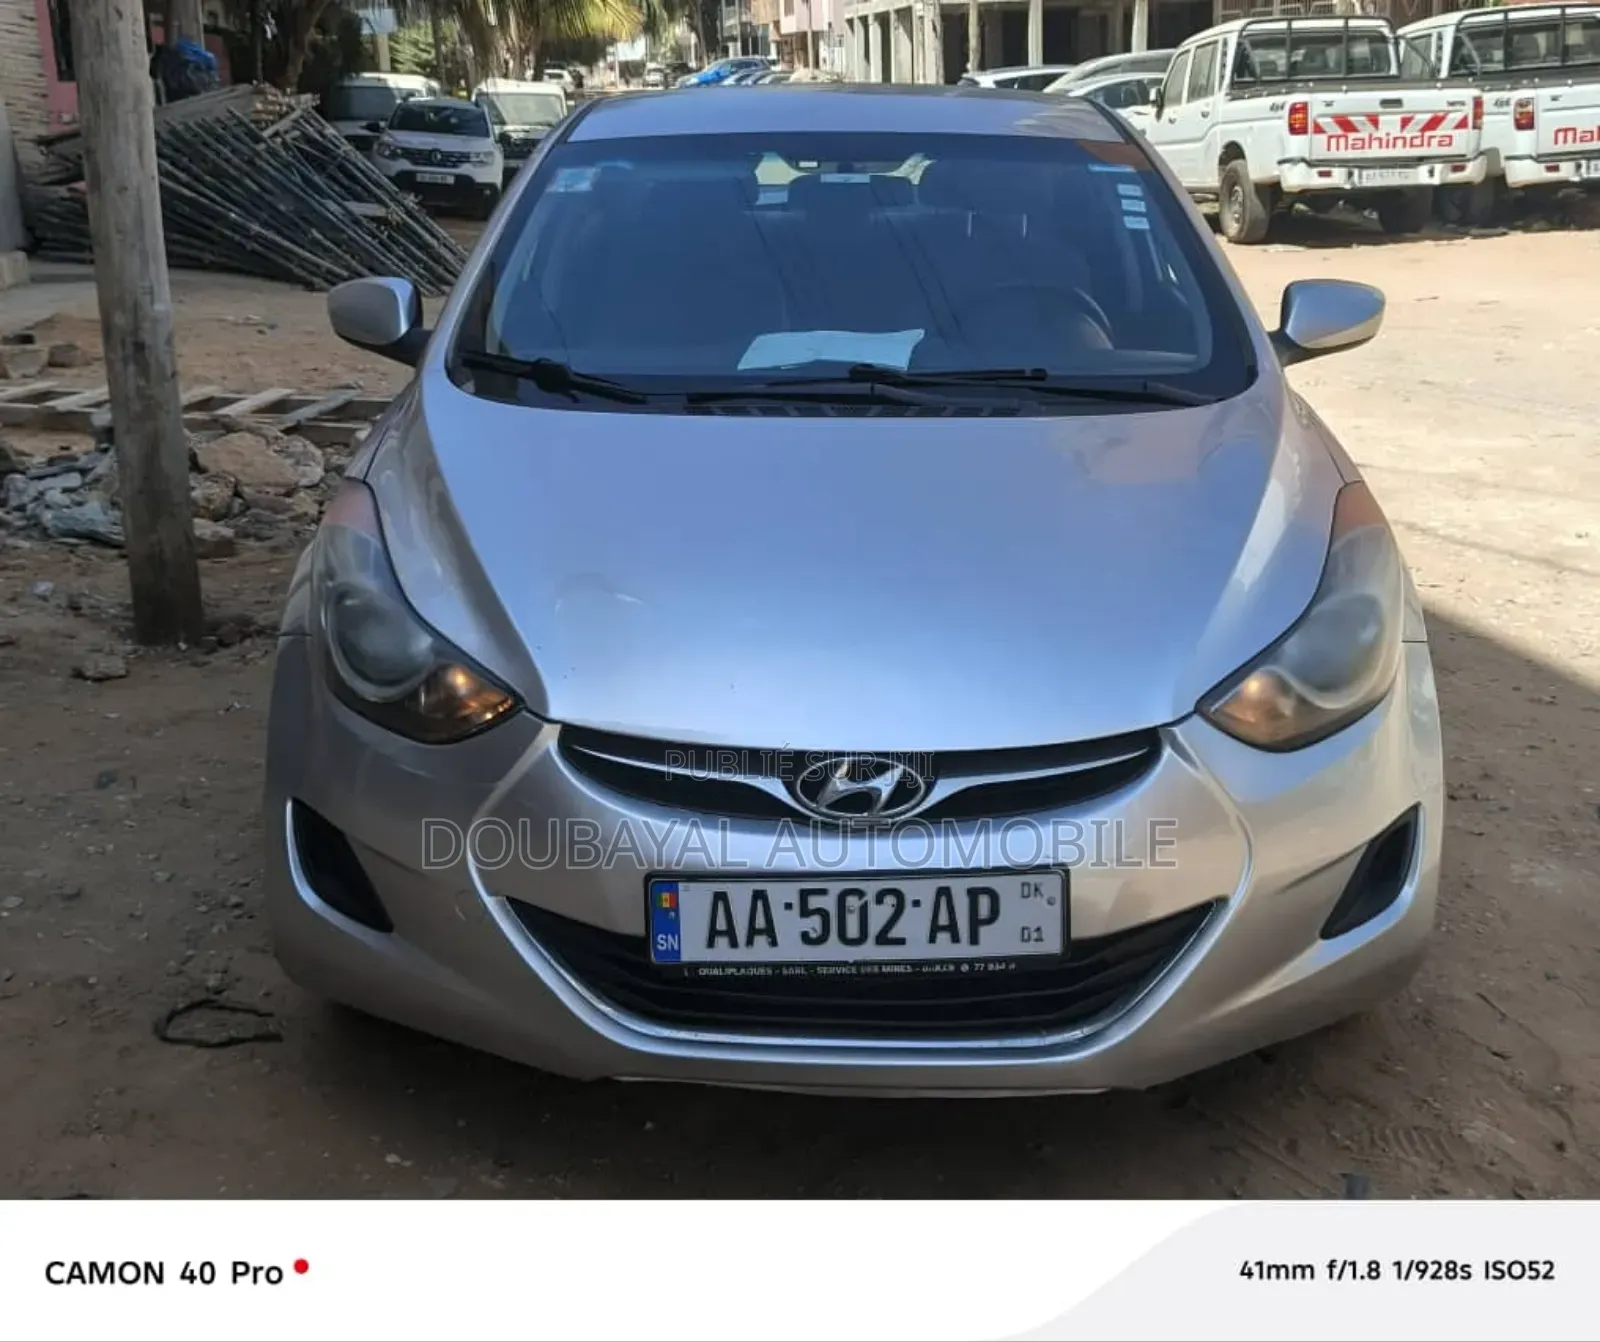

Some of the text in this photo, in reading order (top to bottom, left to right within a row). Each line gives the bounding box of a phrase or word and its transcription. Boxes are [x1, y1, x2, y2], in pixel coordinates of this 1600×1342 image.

[1326, 132, 1454, 152] Mahindra
[1021, 881, 1045, 899] DK
[656, 933, 680, 951] SN
